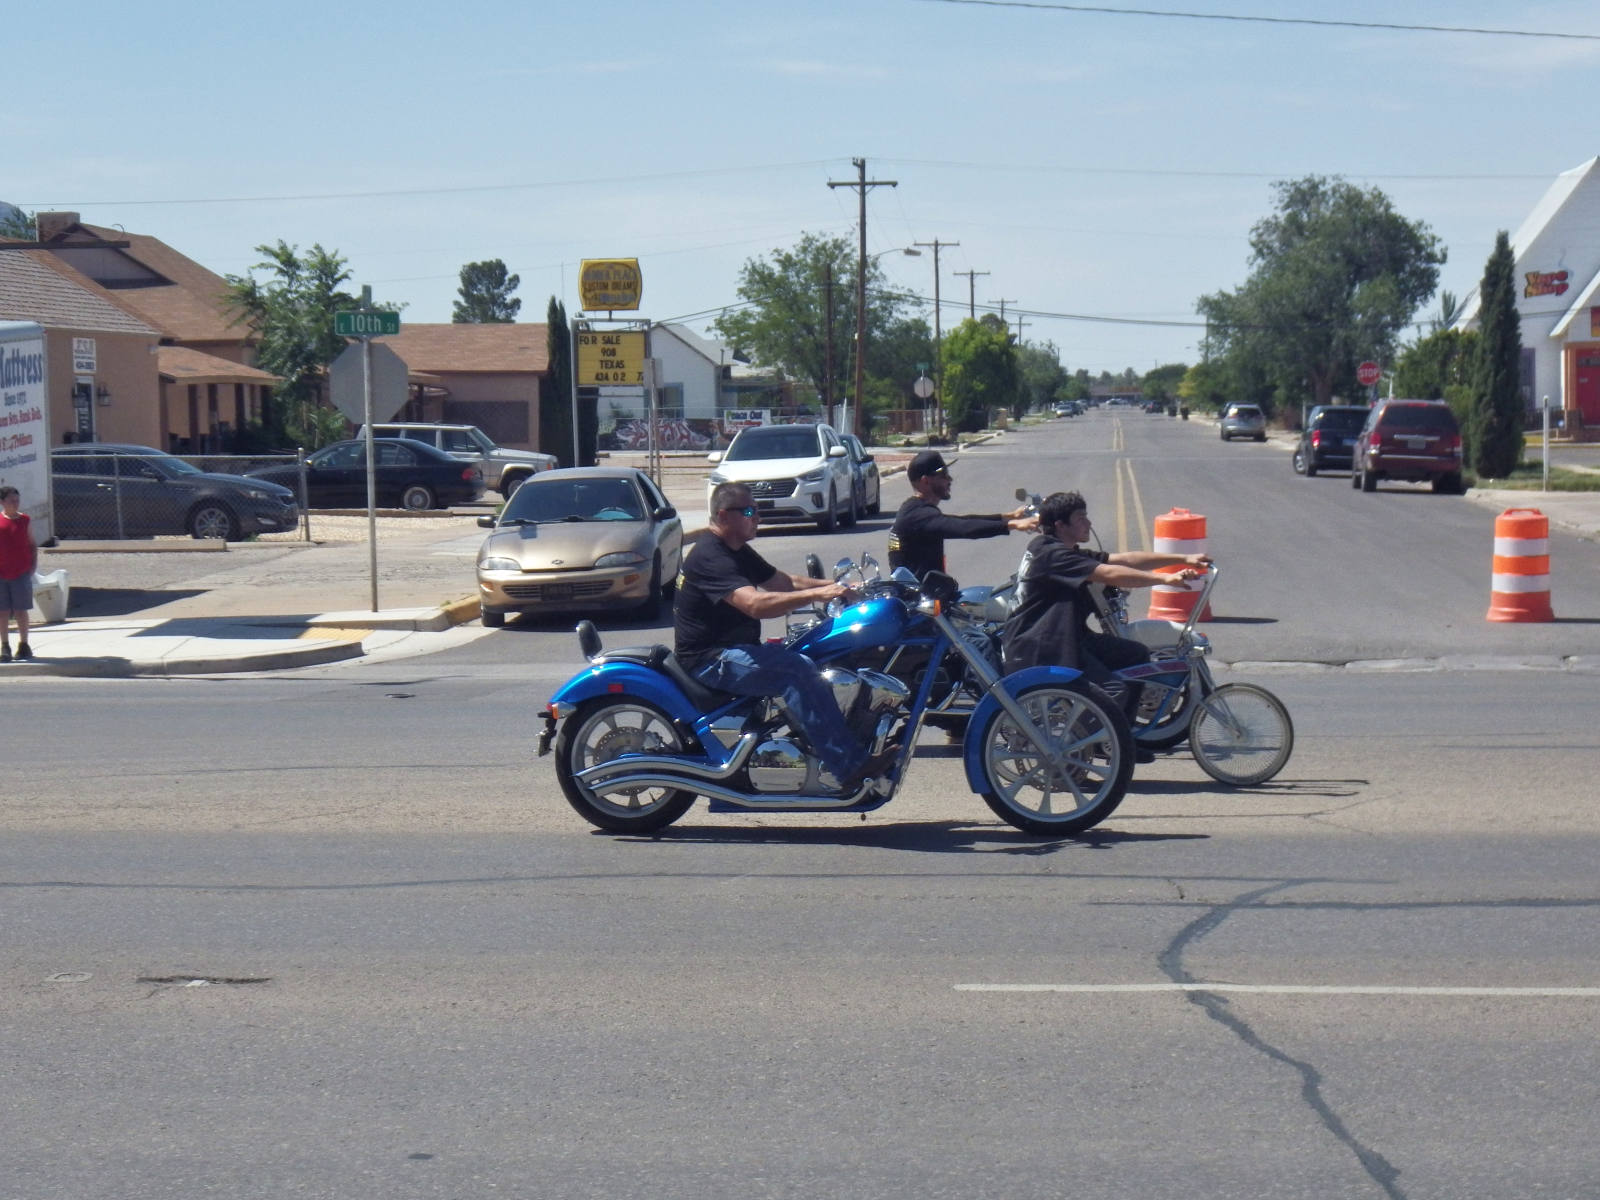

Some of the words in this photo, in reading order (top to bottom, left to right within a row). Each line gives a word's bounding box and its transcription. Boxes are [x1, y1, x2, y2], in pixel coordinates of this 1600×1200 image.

[351, 314, 382, 332] 10th
[579, 335, 598, 345] FOR
[602, 335, 621, 345] SALE
[601, 347, 617, 357] 908
[600, 359, 625, 370] TEXAS
[1358, 367, 1380, 377] STOP
